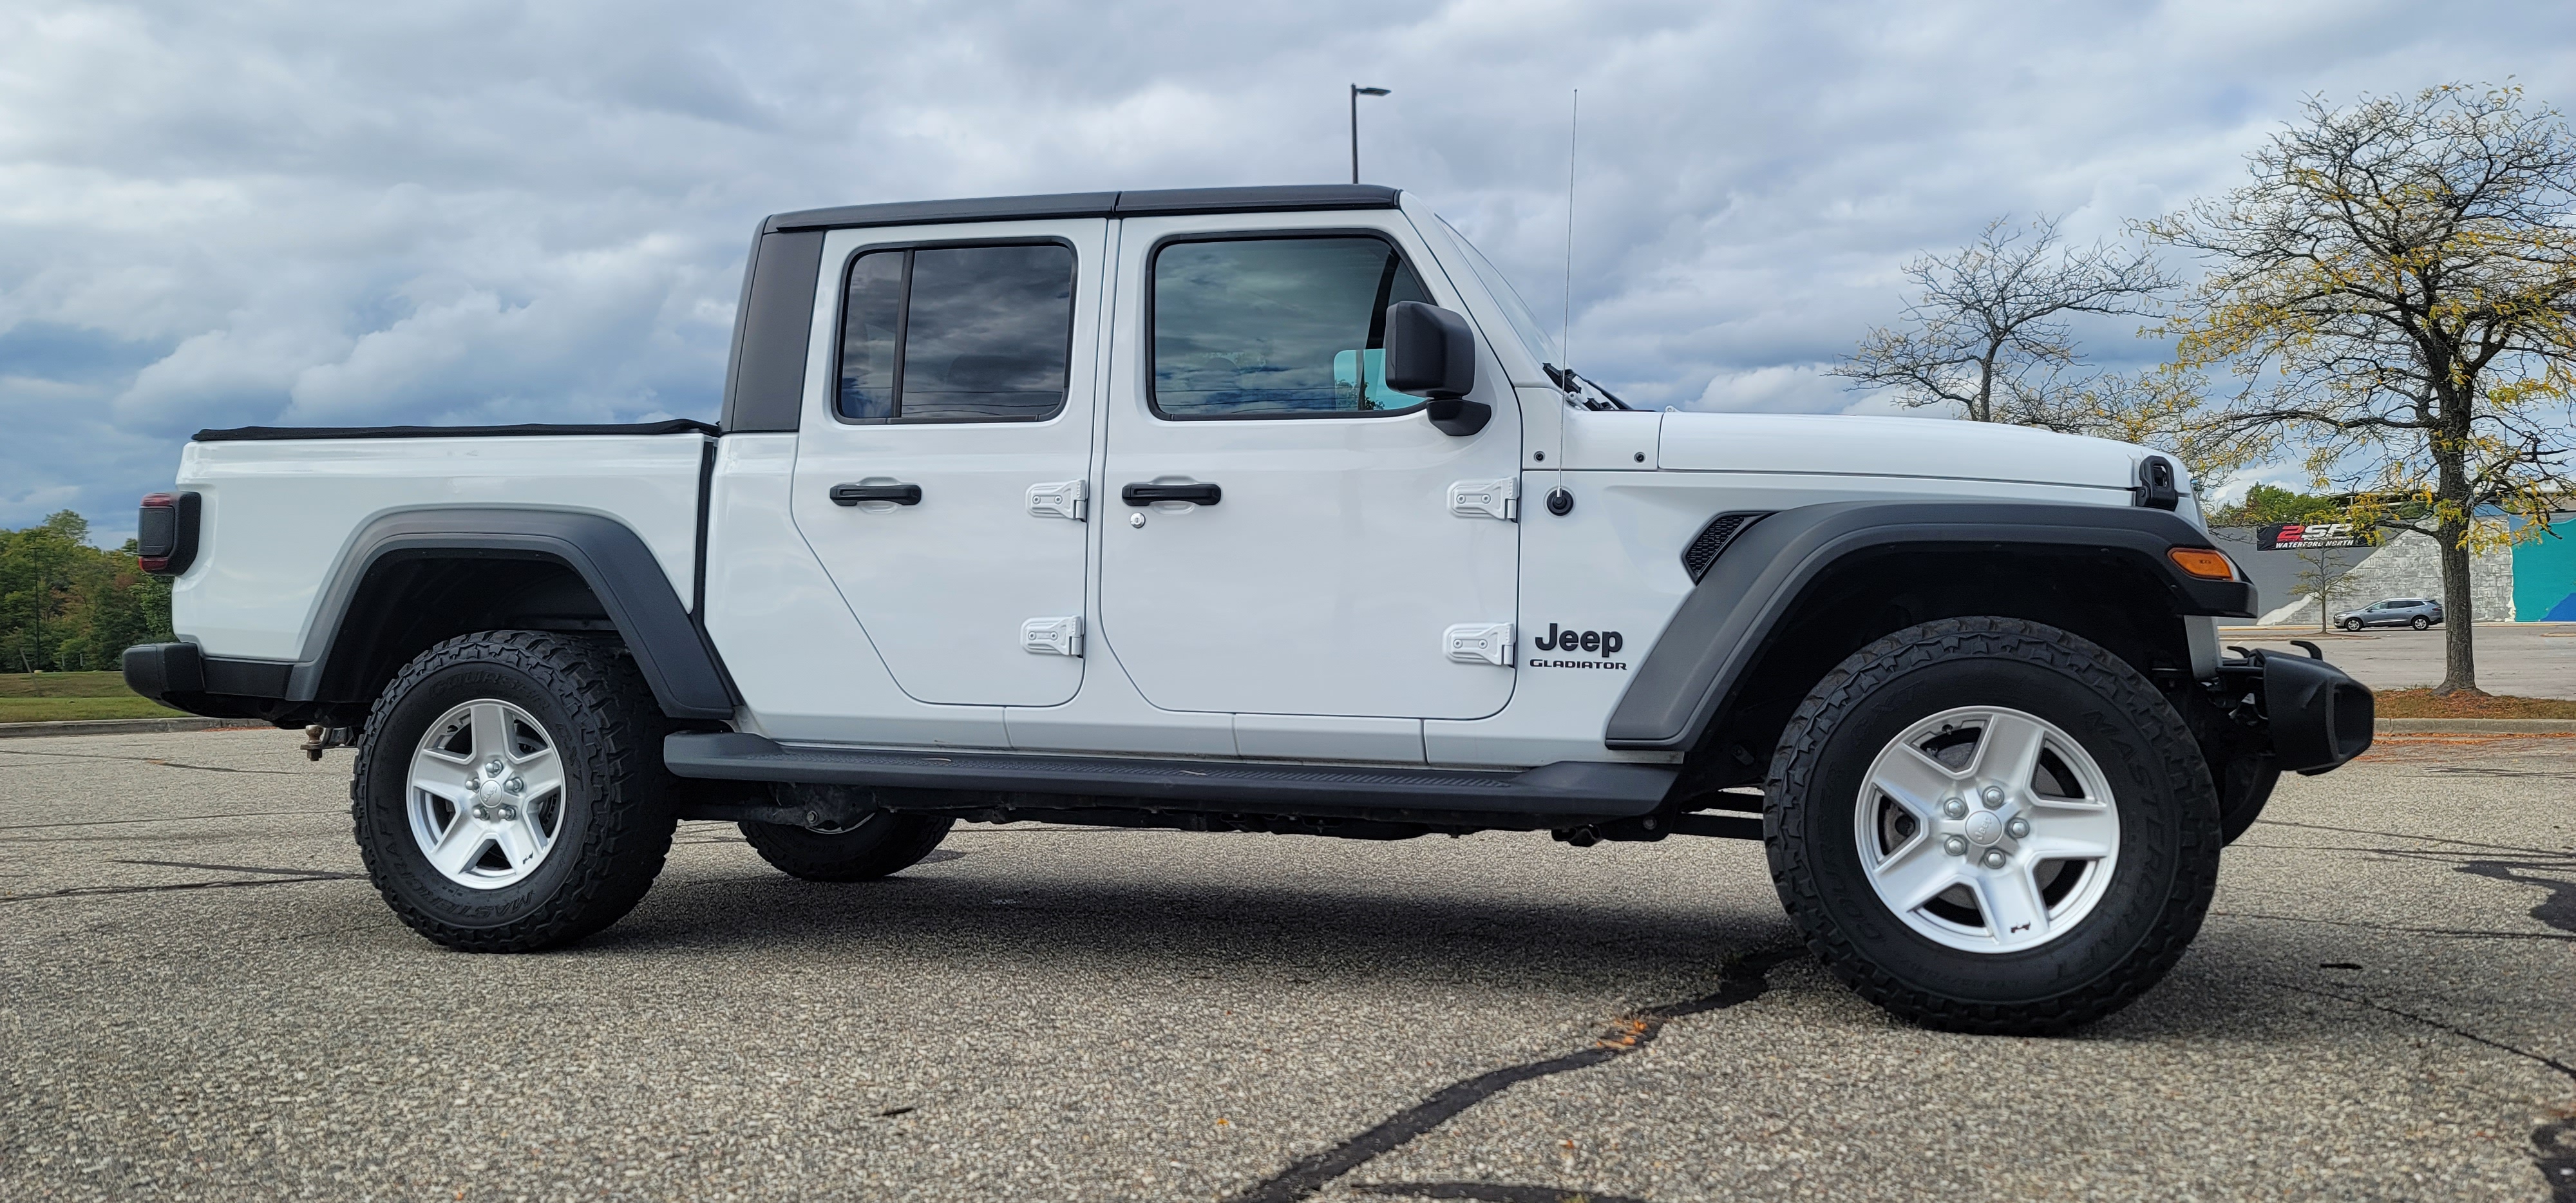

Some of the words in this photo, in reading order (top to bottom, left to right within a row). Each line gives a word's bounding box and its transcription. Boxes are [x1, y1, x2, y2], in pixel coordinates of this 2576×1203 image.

[1535, 622, 1623, 658] Jeep
[1530, 659, 1627, 670] GLADIATOR
[1975, 816, 1992, 841] Jeep
[375, 796, 533, 918] MASTERCRAFT
[2048, 709, 2164, 985] MASTERCRAFT
